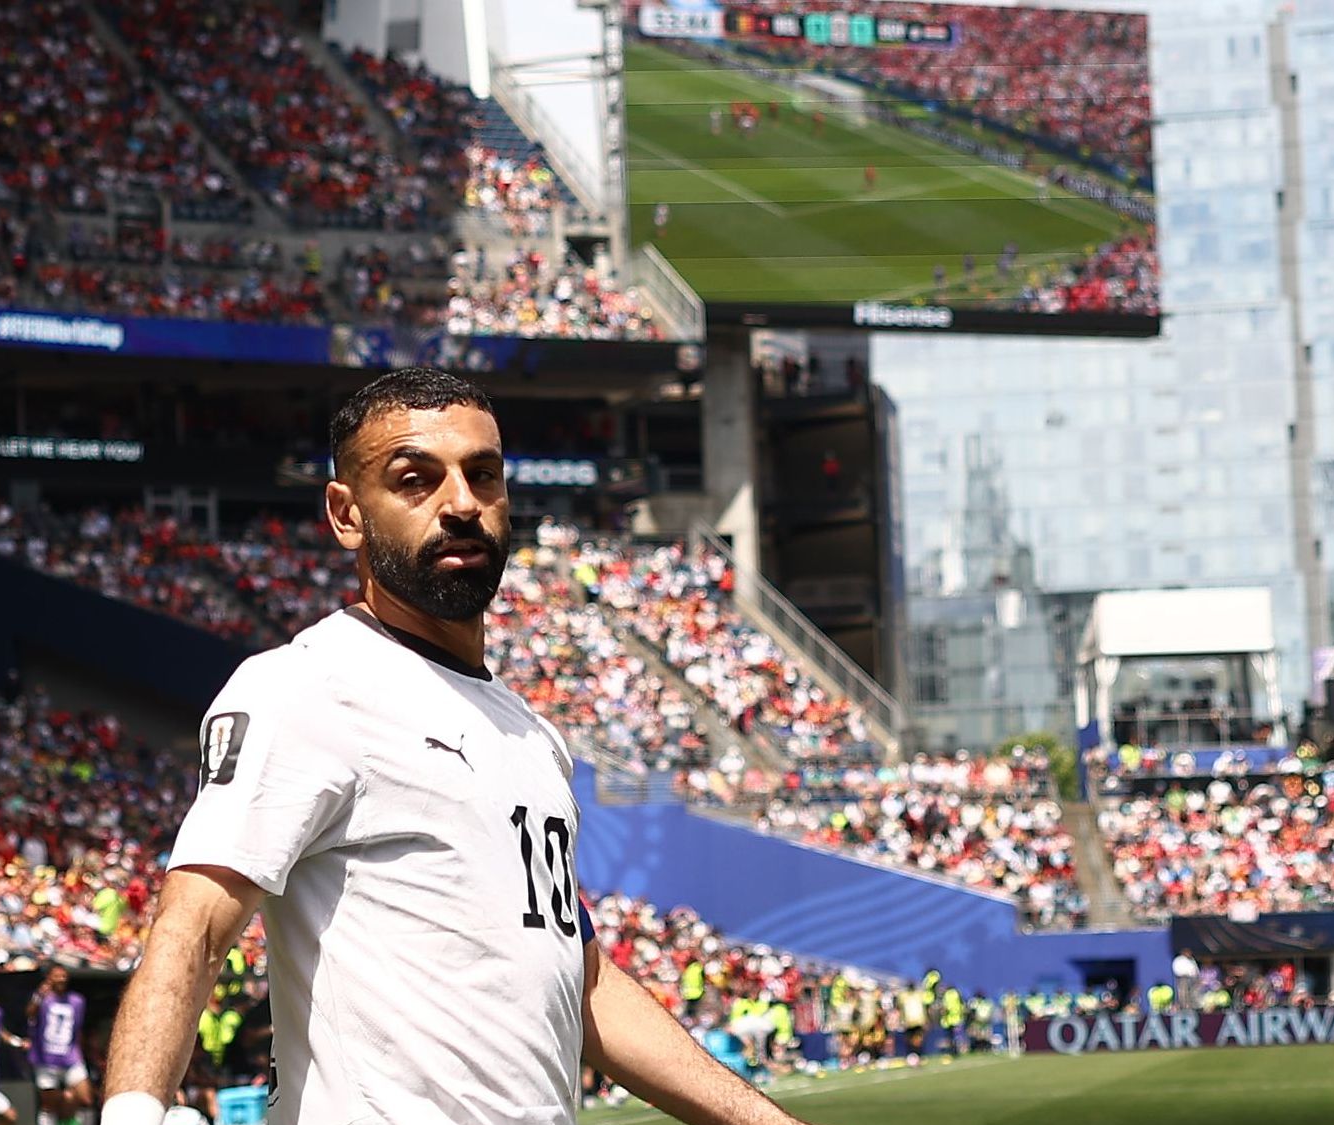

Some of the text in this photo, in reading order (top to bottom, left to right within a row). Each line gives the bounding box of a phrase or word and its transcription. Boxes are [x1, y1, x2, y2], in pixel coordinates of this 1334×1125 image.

[516, 459, 598, 485] 2026
[510, 805, 576, 938] 10
[1047, 1009, 1202, 1056] QATAR
